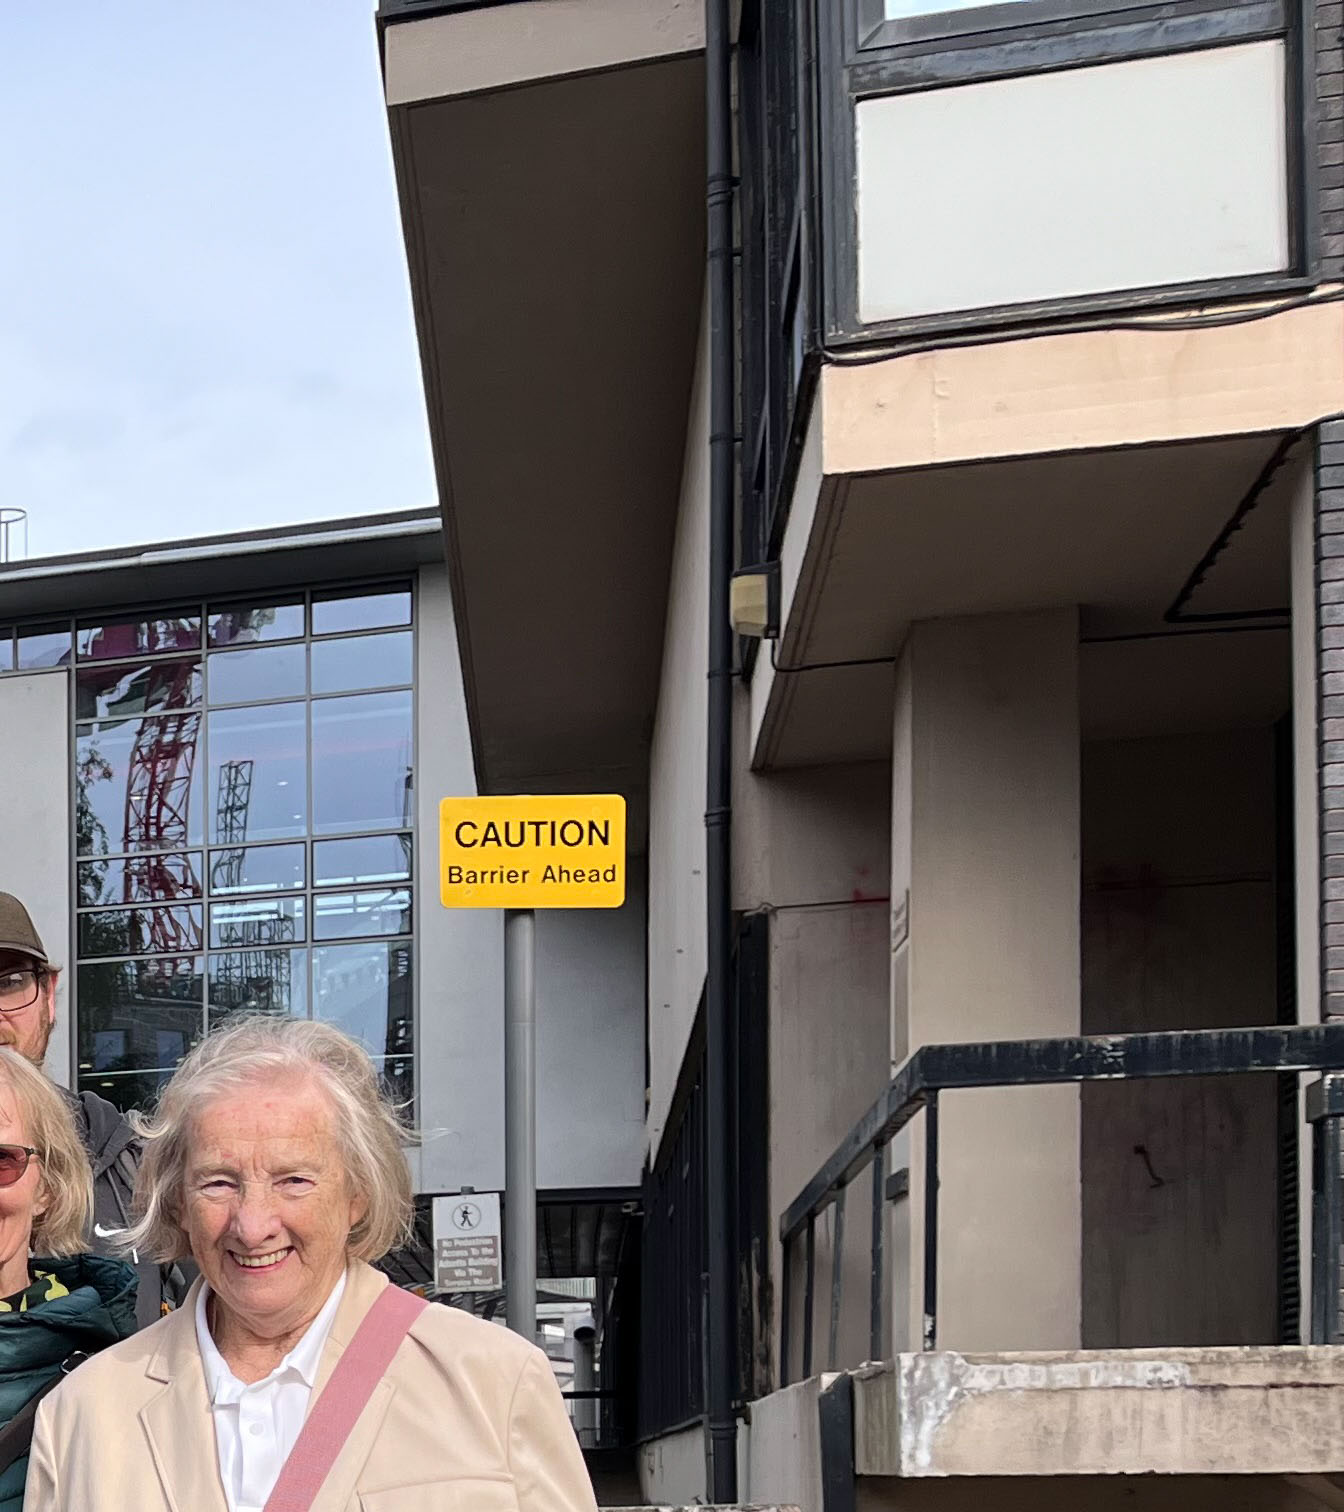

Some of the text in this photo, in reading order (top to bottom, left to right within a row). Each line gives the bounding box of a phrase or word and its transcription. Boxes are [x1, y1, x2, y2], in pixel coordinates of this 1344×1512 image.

[455, 820, 610, 848] CAUTION
[448, 864, 617, 884] Barrier Ahead
